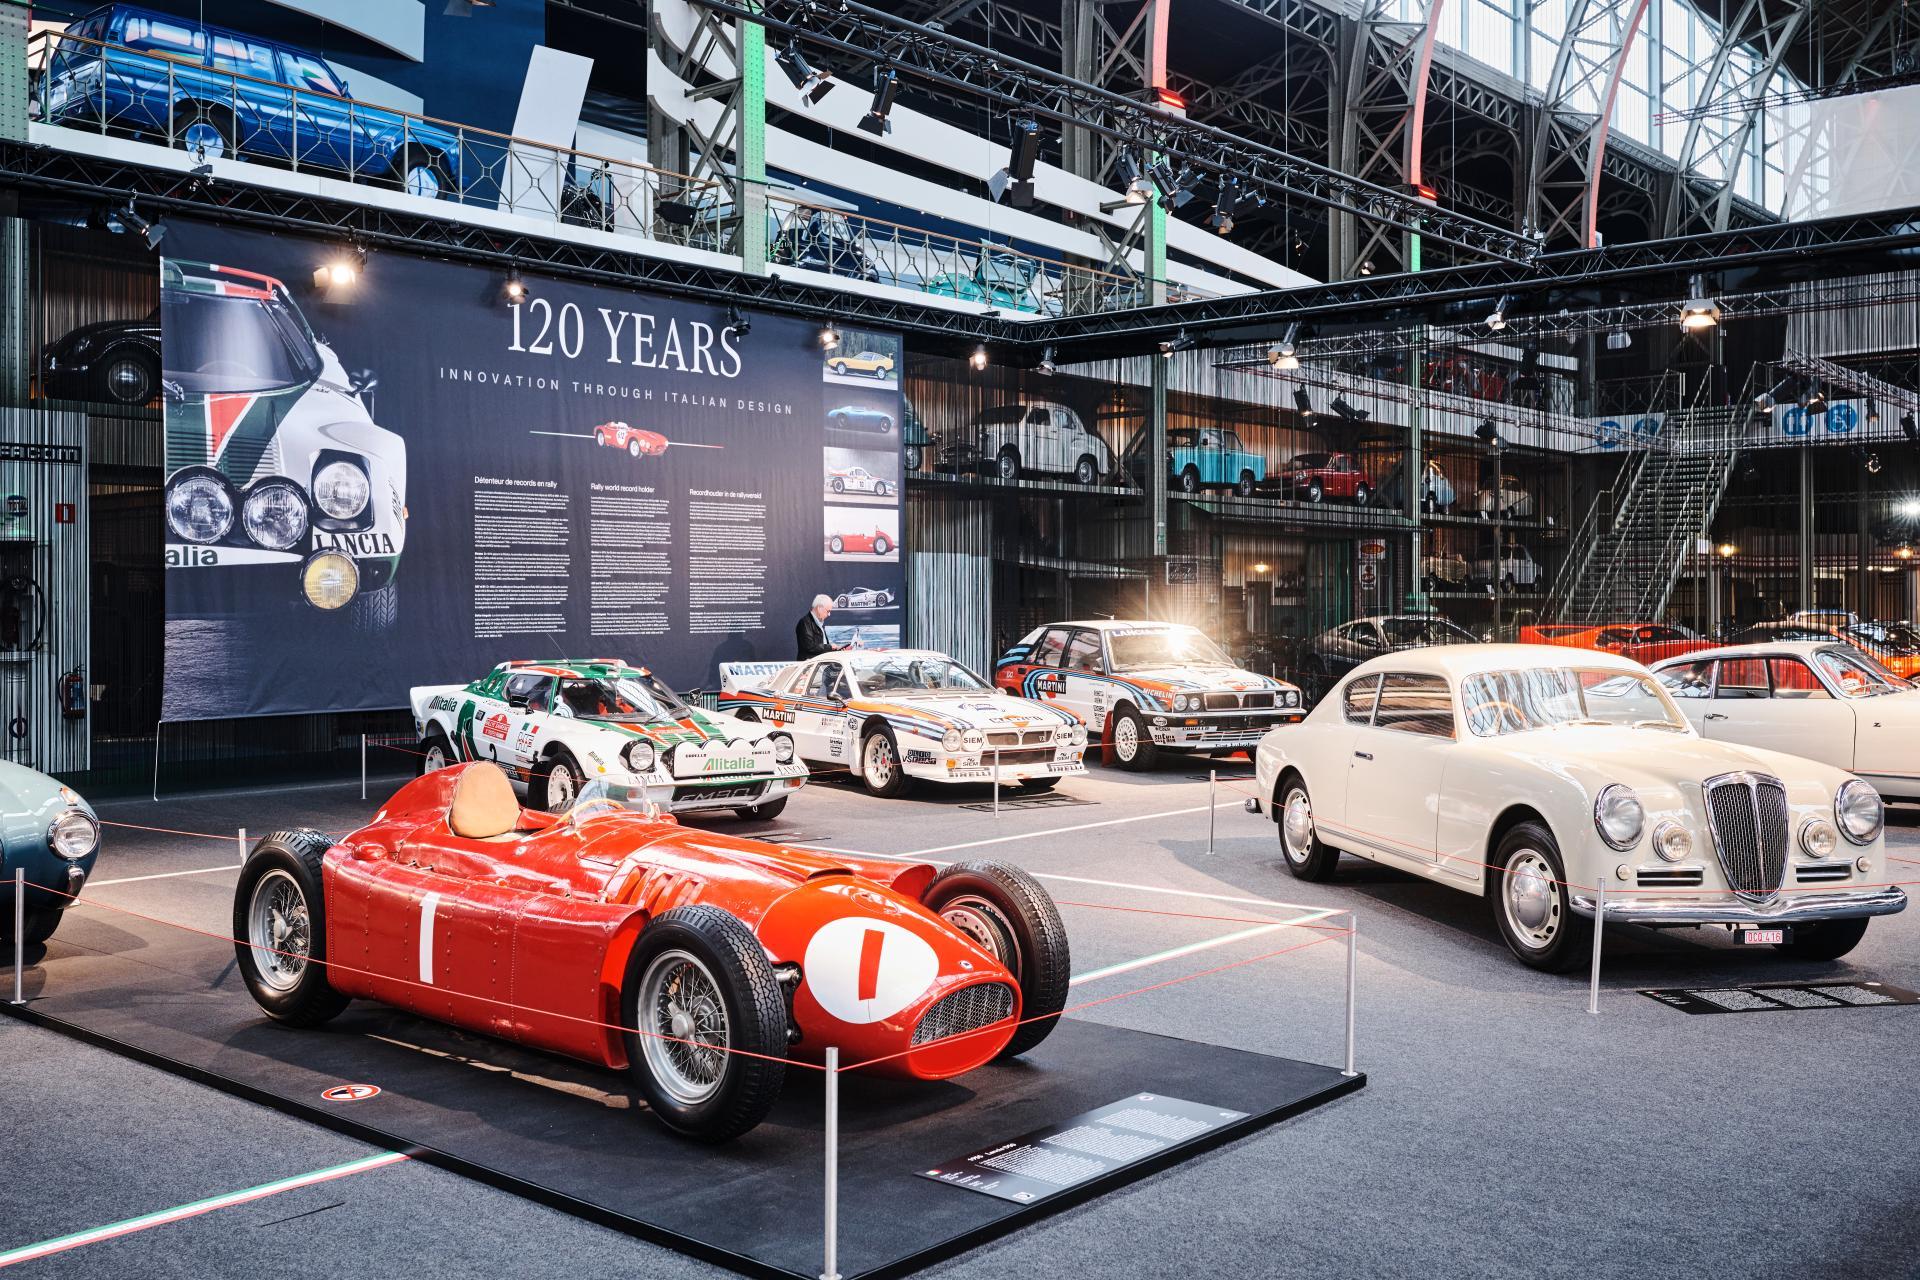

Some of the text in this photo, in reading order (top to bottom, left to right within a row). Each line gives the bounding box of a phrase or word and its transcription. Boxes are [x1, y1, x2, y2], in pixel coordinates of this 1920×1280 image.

[507, 298, 742, 378] 120 YEARS
[440, 367, 793, 415] INNOVATION THROUGH ITALIAN DESIGN
[474, 476, 504, 485] Détenteur
[513, 479, 537, 487] records
[545, 480, 557, 488] rally
[590, 483, 604, 492] Rally
[314, 533, 396, 555] LANCIA
[165, 545, 219, 566] alia
[1037, 680, 1066, 693] MARTINI
[1143, 687, 1173, 698] MICHELIN
[428, 696, 458, 712] Alitalia
[762, 708, 795, 723] MARTINI
[963, 736, 983, 744] SIEM
[1056, 731, 1073, 740] SIEM
[702, 757, 755, 771] Alitalia
[419, 892, 440, 984] 1
[858, 929, 885, 1001] 1
